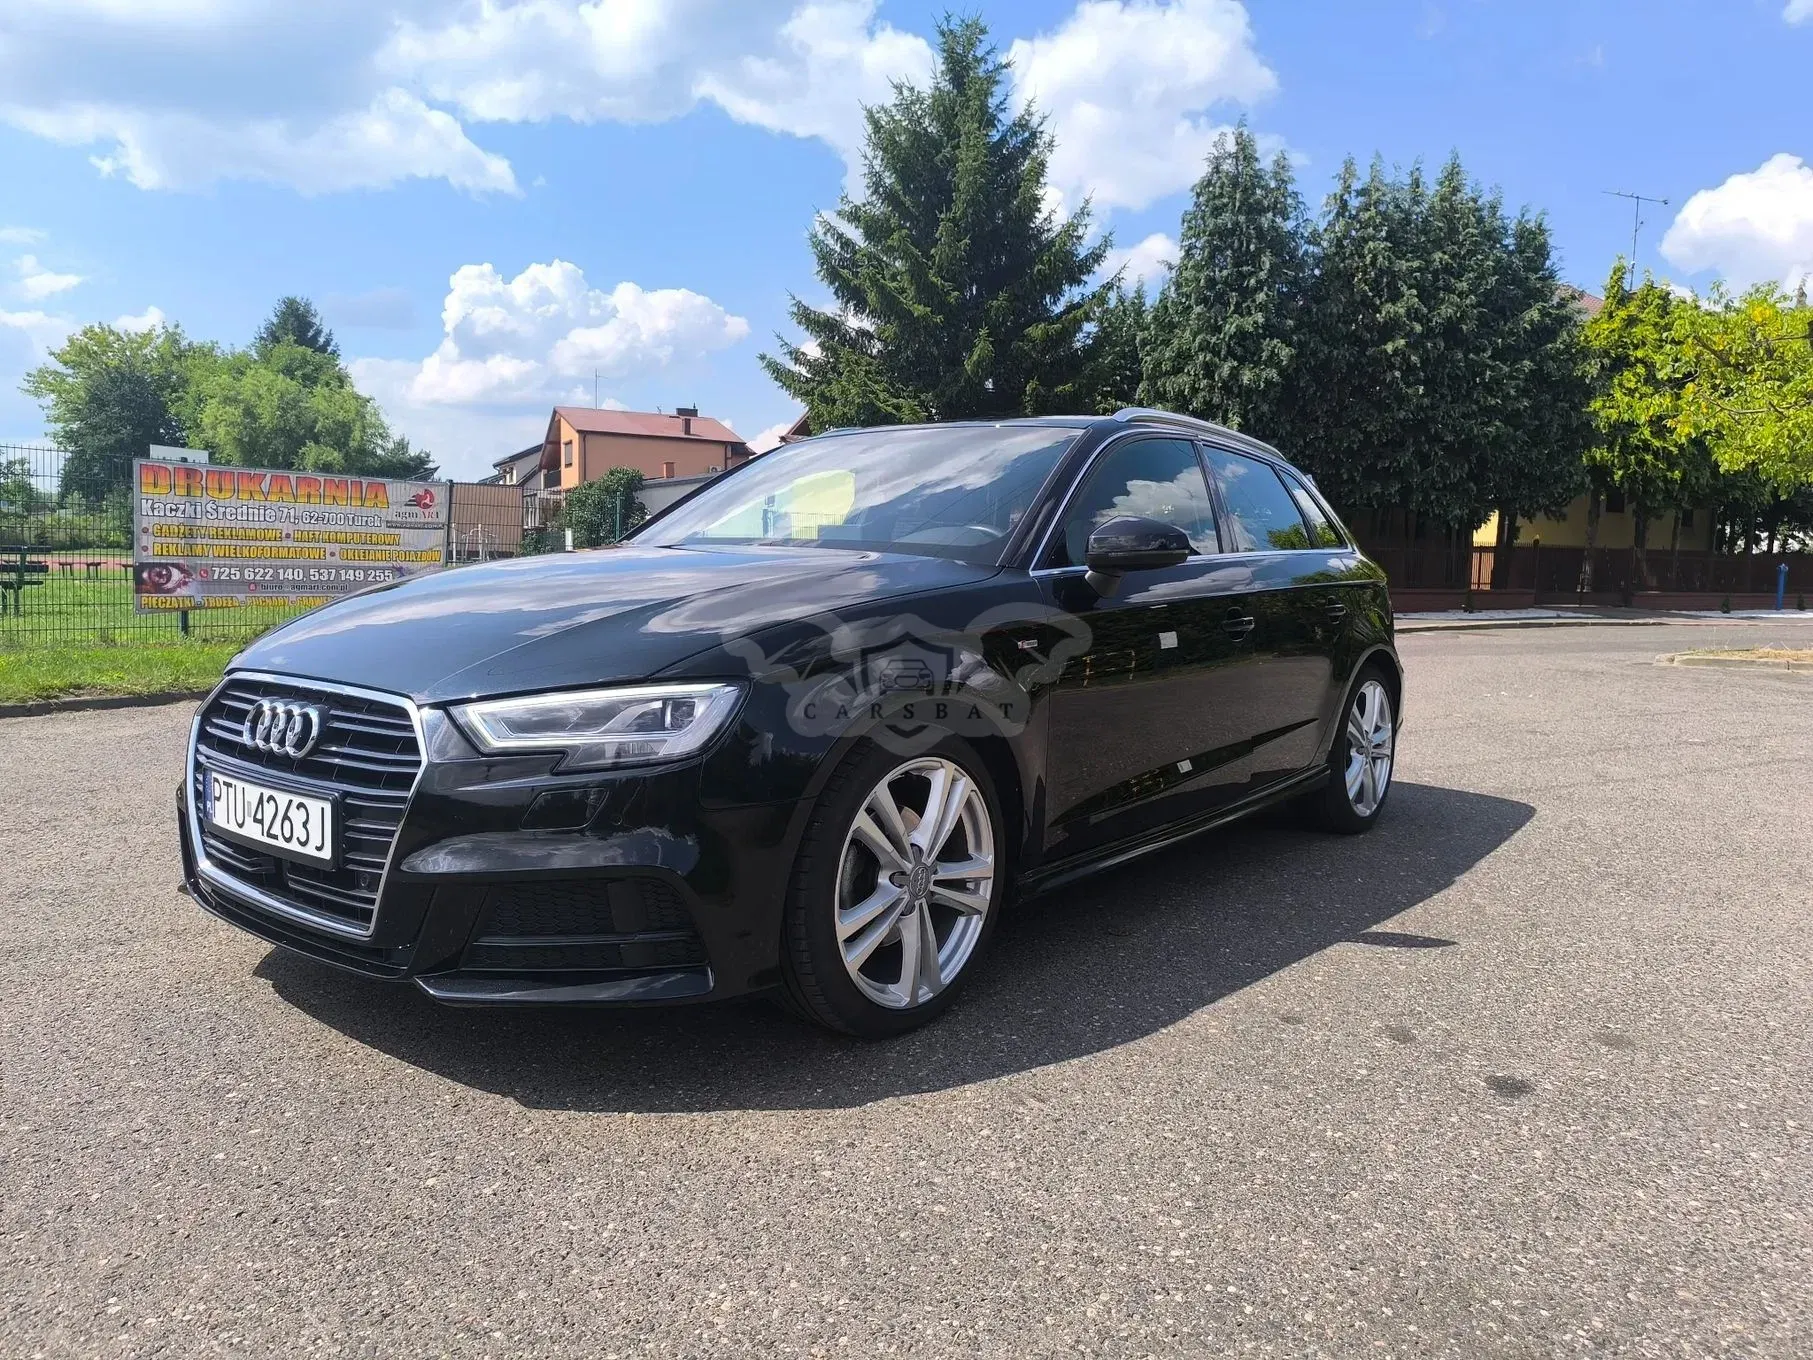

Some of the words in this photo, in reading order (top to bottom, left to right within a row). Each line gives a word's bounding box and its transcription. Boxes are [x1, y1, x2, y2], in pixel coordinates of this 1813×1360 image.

[140, 463, 389, 509] DRUKARNIA
[140, 498, 203, 519] Kaczki
[205, 500, 277, 523] Średnie
[279, 505, 299, 522] 71,
[302, 511, 344, 526] 62-700
[346, 514, 382, 528] Turek
[152, 523, 207, 539] GADŻETY
[208, 526, 283, 542] REKLAMOWE
[293, 530, 322, 543] HAFT
[322, 531, 401, 546] KOMPUTEROWY
[152, 542, 211, 557] REKLAMY
[211, 544, 327, 560] WIELKOFORMATOWE
[339, 547, 392, 562] OKLEJANIE
[211, 567, 241, 580] 725
[244, 568, 274, 580] 622
[276, 568, 308, 582] 140,
[309, 569, 338, 582] 537
[338, 569, 365, 582] 149
[367, 570, 394, 583] 255
[213, 776, 245, 829] PTU
[253, 791, 325, 852] 4263J
